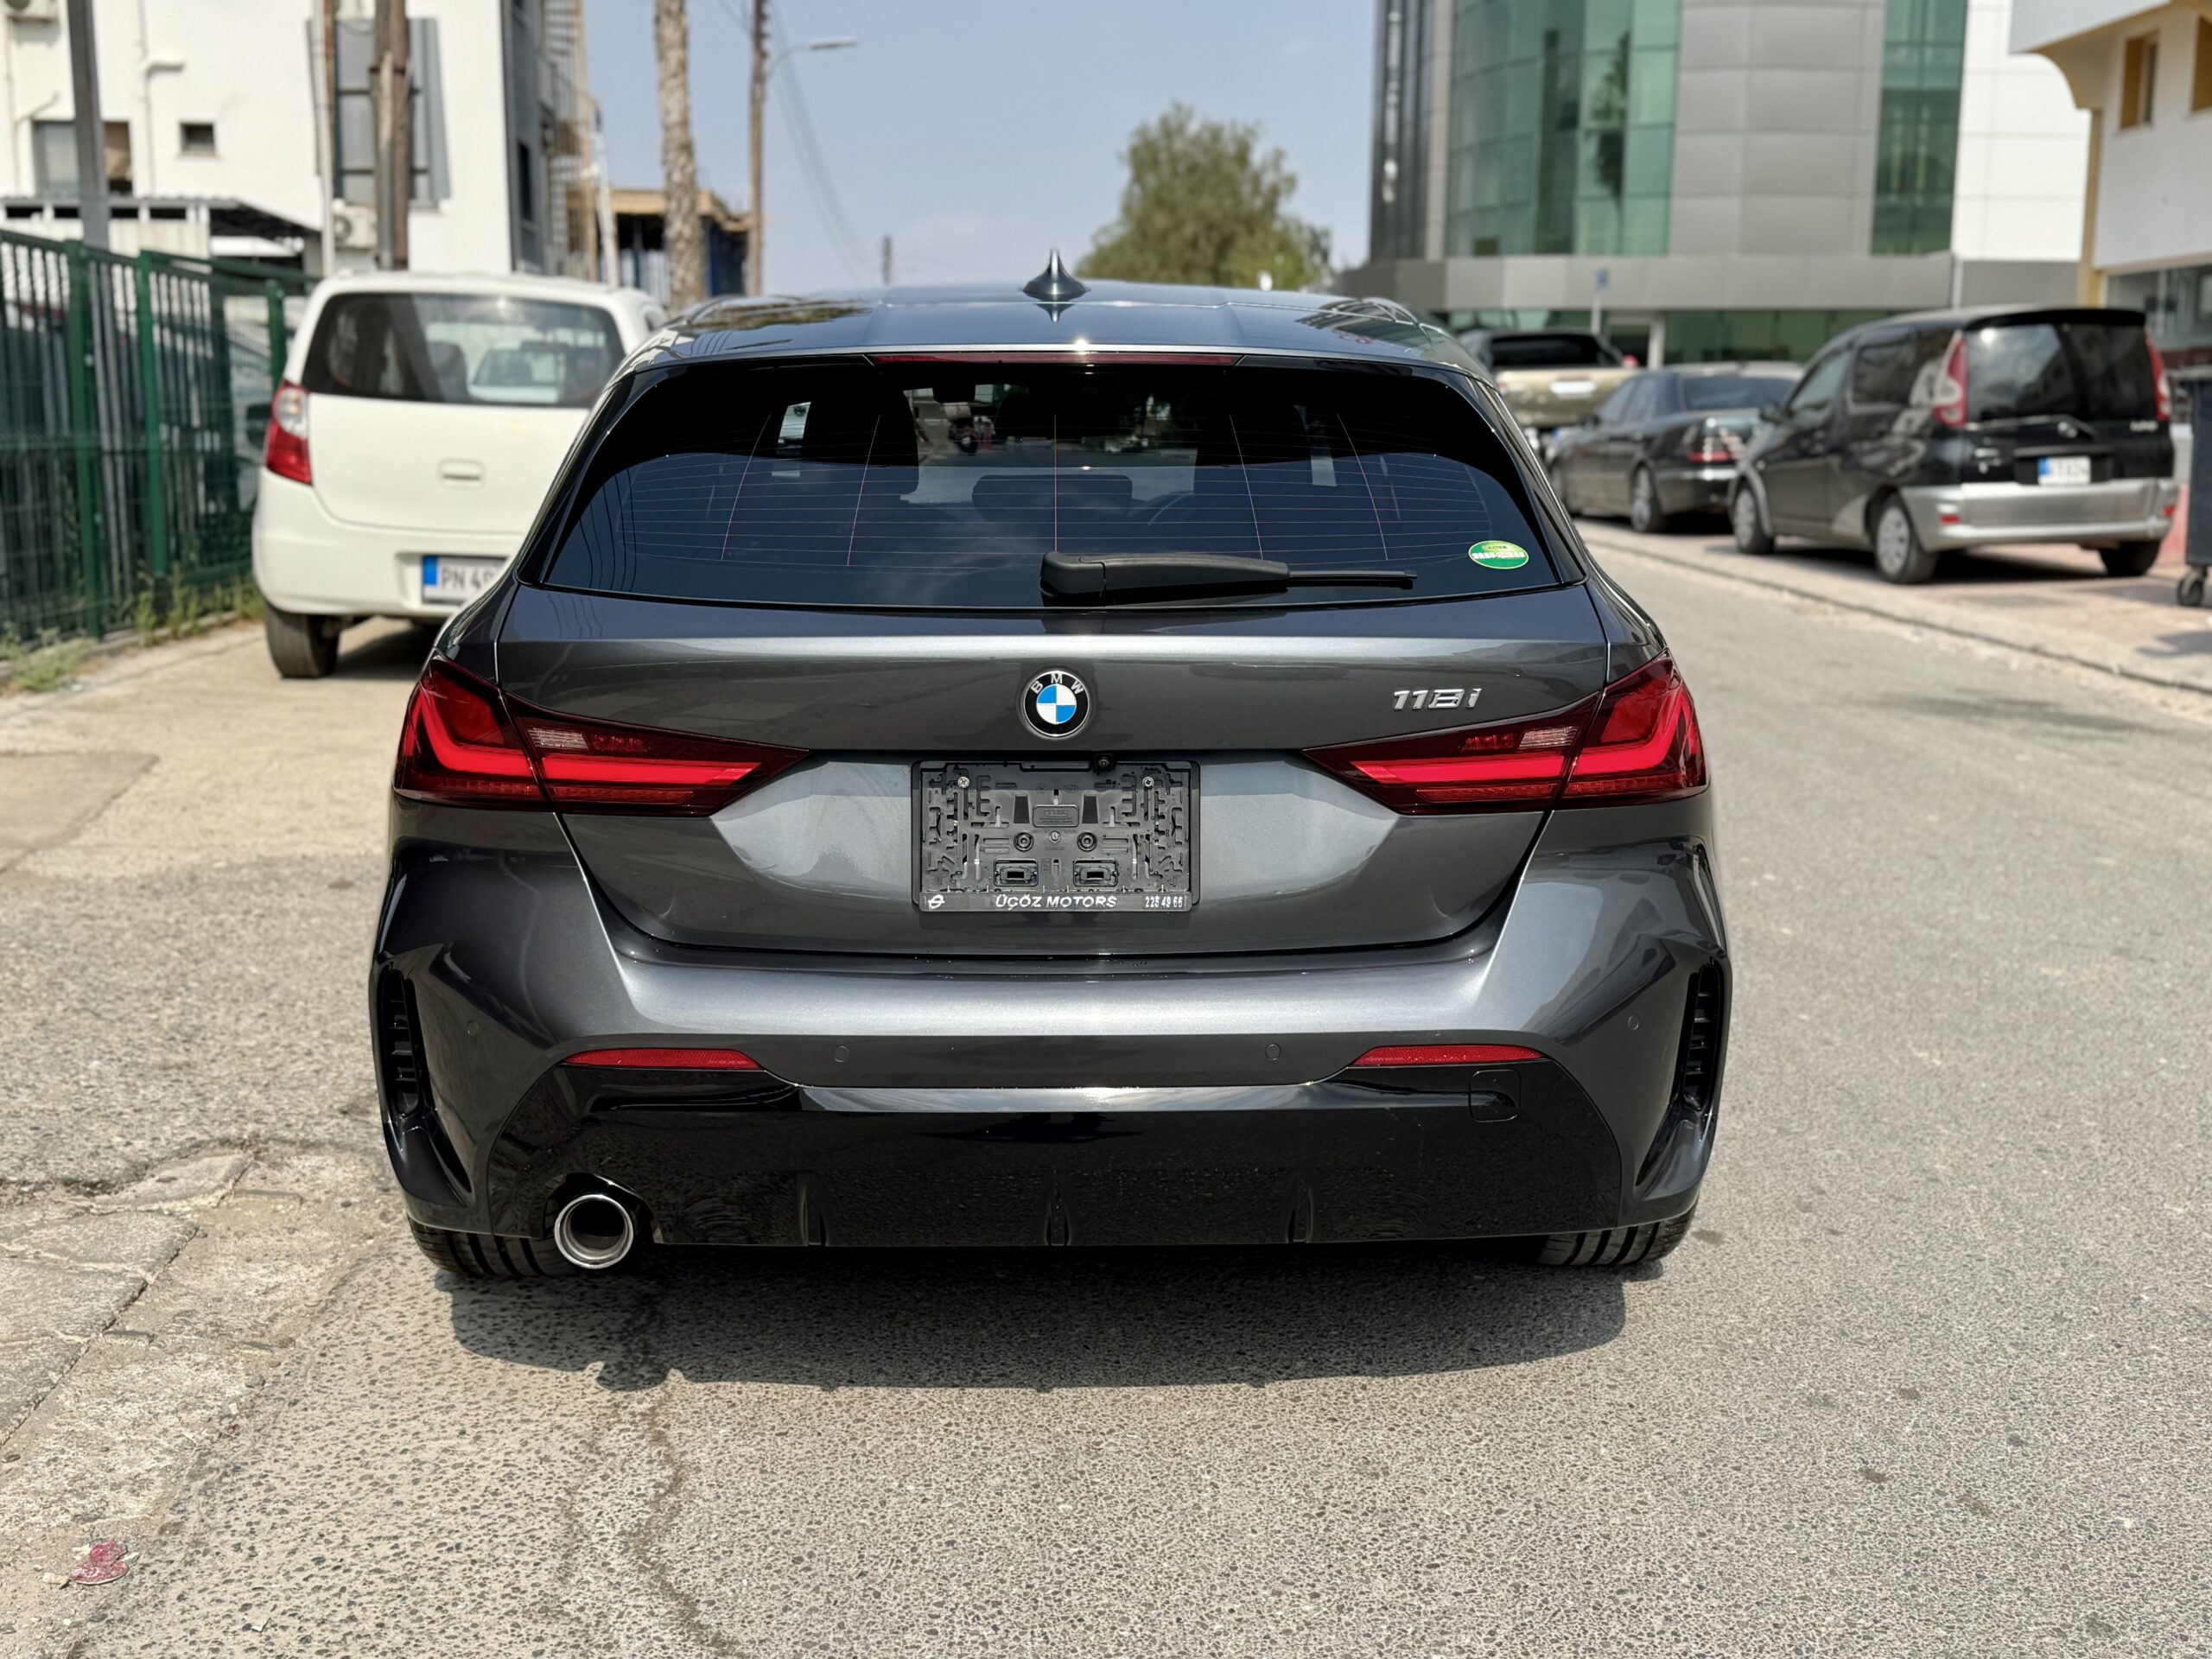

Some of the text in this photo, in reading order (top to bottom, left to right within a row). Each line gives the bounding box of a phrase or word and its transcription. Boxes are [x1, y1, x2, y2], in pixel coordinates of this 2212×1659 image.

[1030, 673, 1084, 695] BMW
[1394, 688, 1482, 709] 118i
[995, 894, 1117, 910] ÜÇÖZ MOTORS
[1173, 895, 1184, 908] 66
